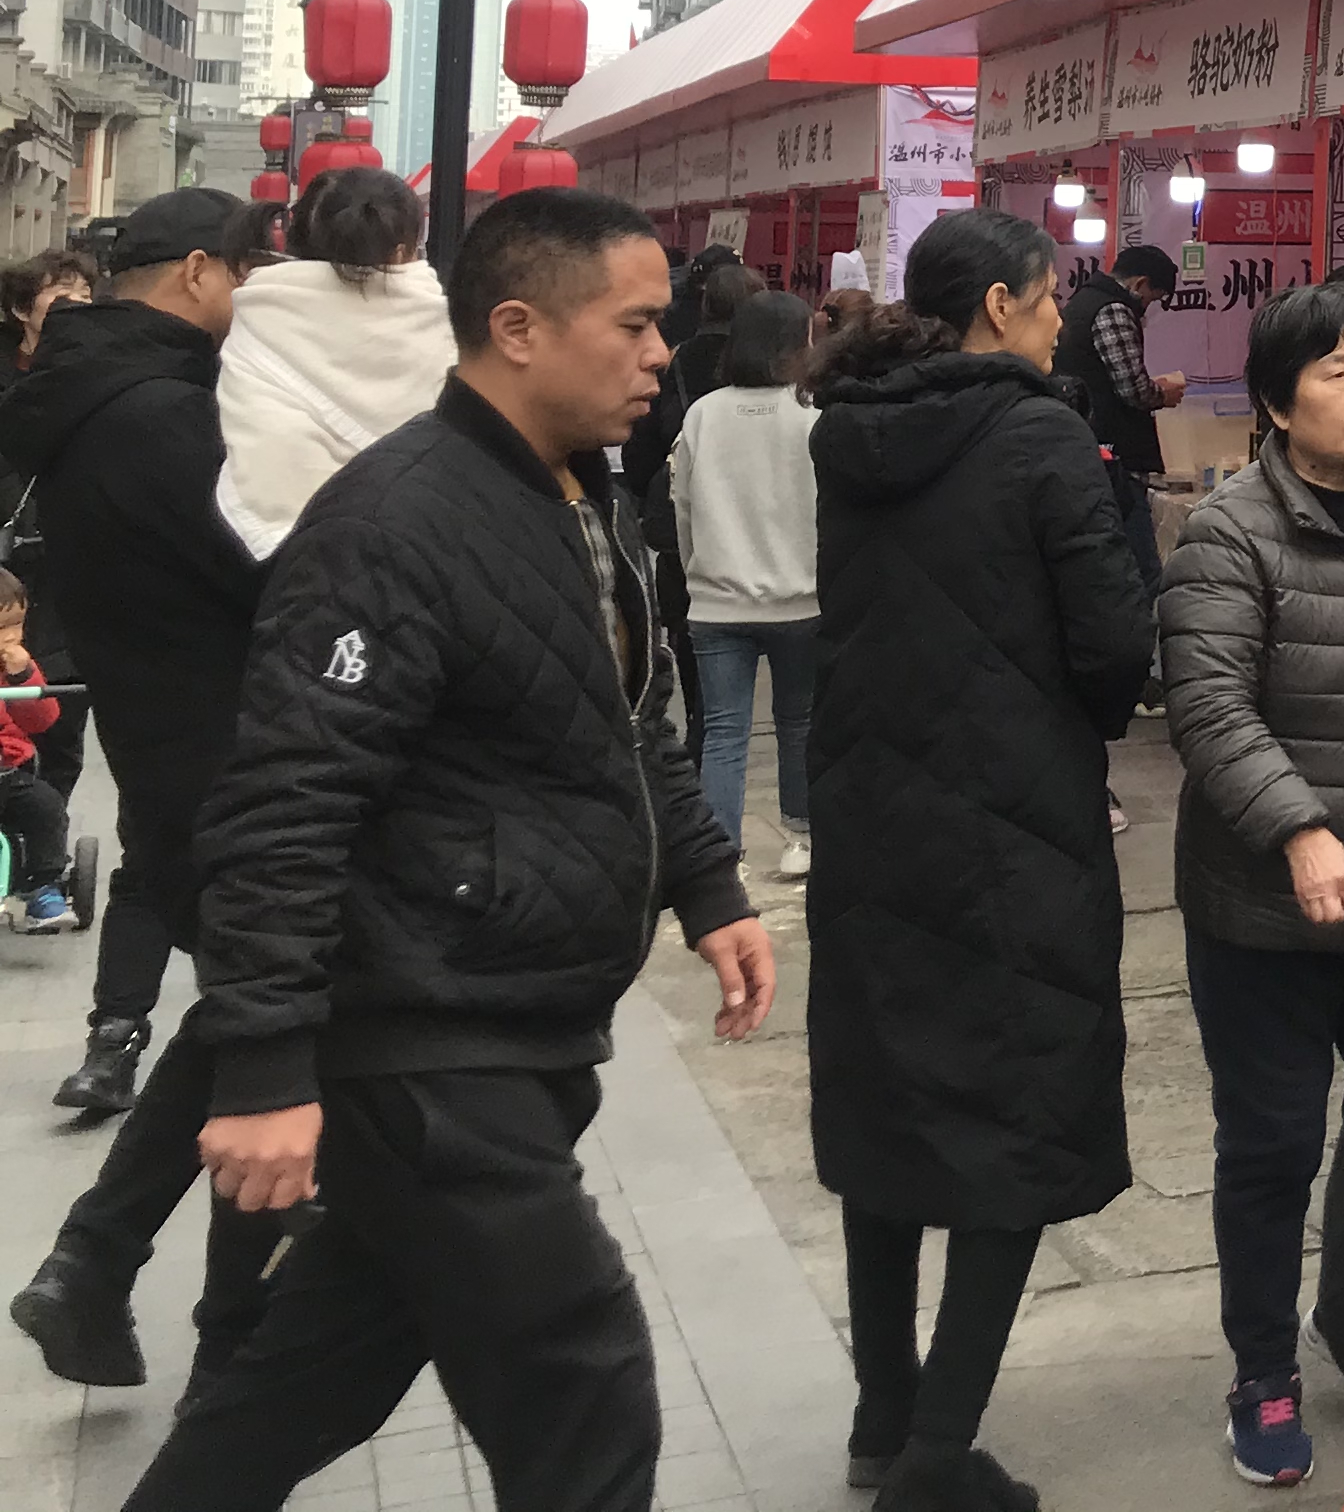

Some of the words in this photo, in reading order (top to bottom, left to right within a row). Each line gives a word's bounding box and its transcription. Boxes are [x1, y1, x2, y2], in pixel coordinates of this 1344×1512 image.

[1186, 17, 1280, 100] 骆驼奶粉
[1234, 198, 1313, 239] 温州
